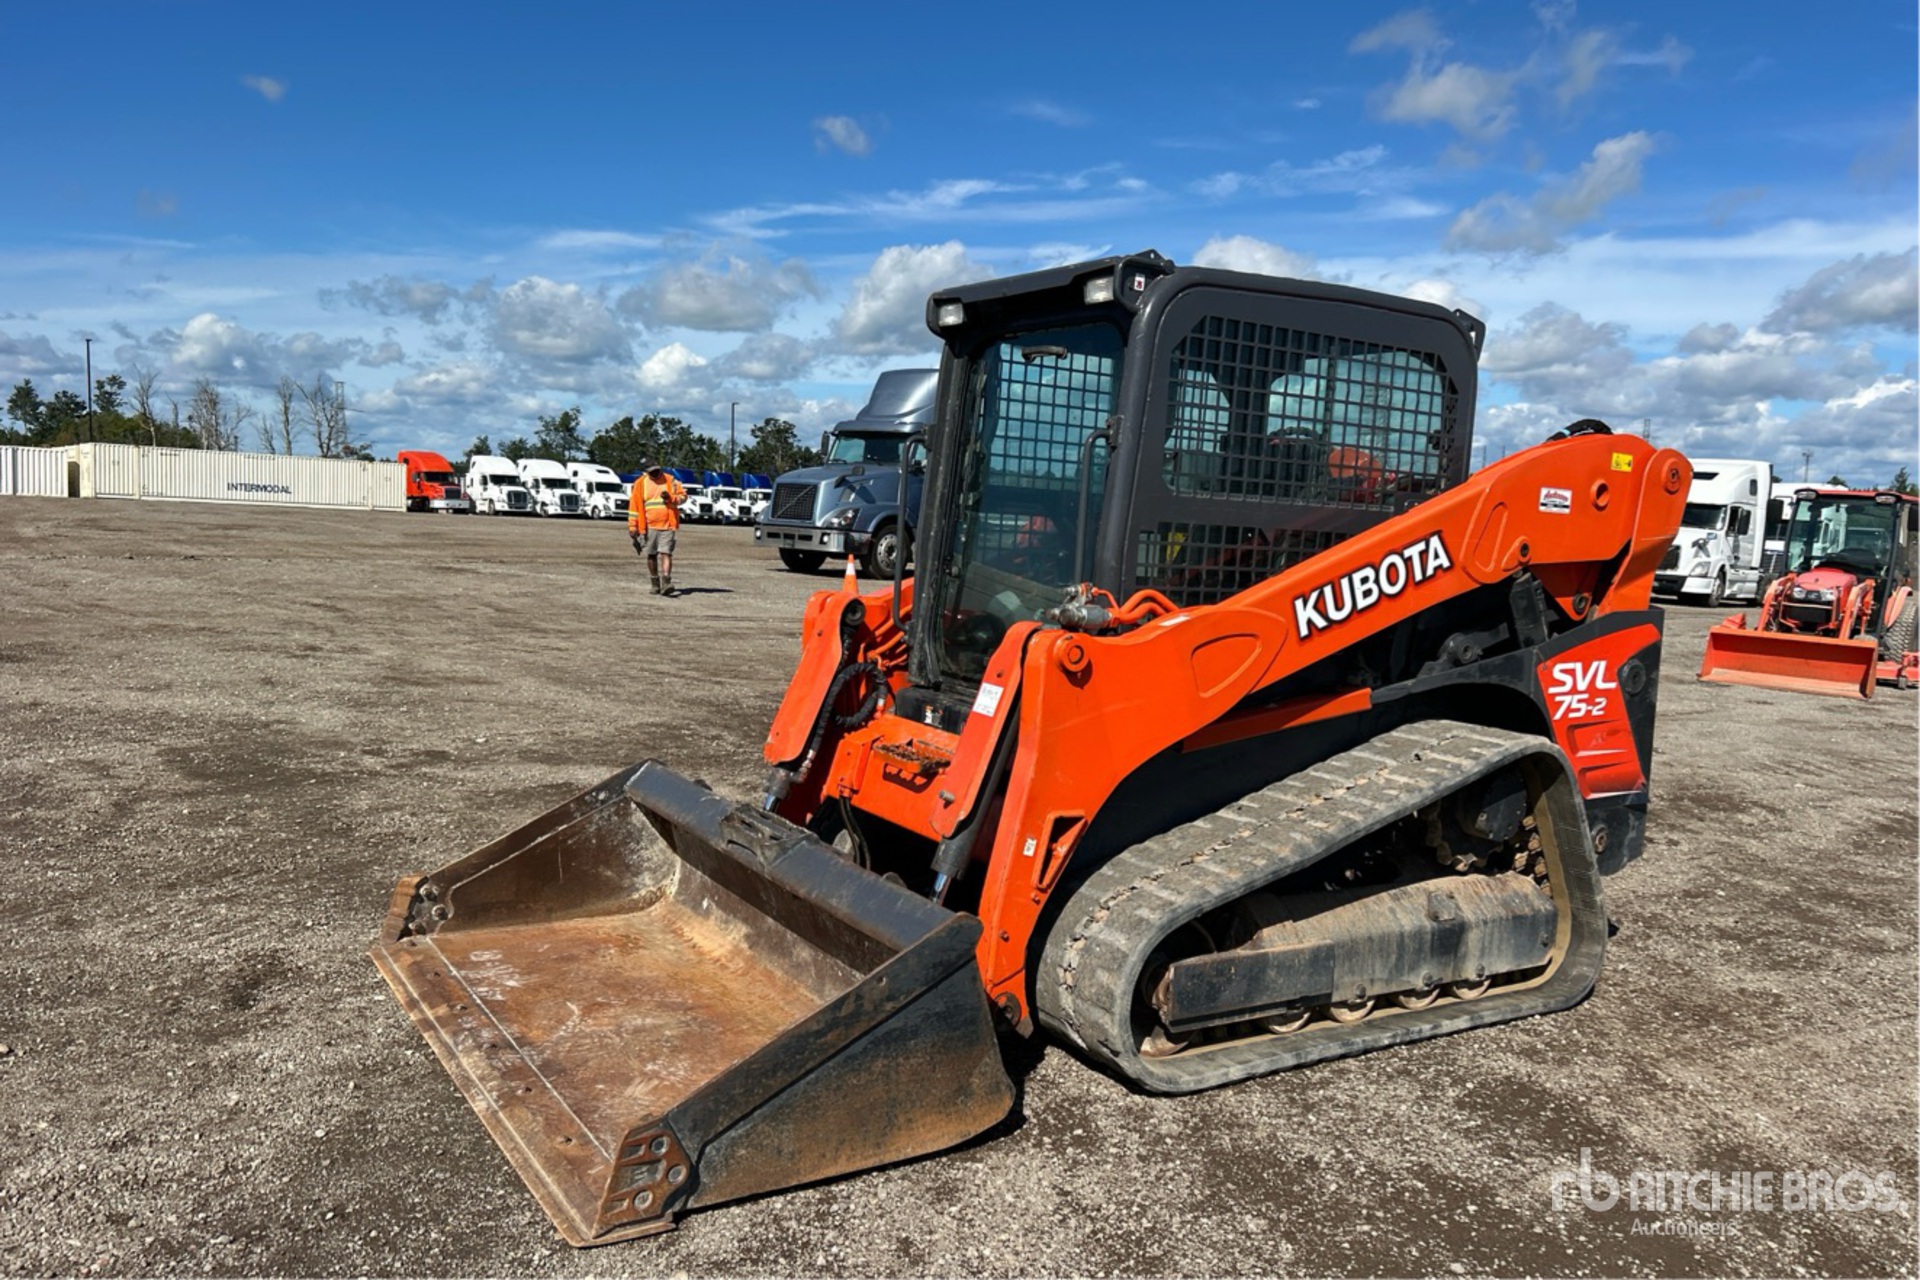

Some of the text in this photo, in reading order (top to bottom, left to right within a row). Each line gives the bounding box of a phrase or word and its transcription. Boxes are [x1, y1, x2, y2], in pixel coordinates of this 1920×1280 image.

[227, 482, 292, 494] INTERMODAL
[1294, 533, 1451, 638] KUBOTA
[1548, 660, 1617, 694] SVL
[1553, 693, 1607, 720] 75-2
